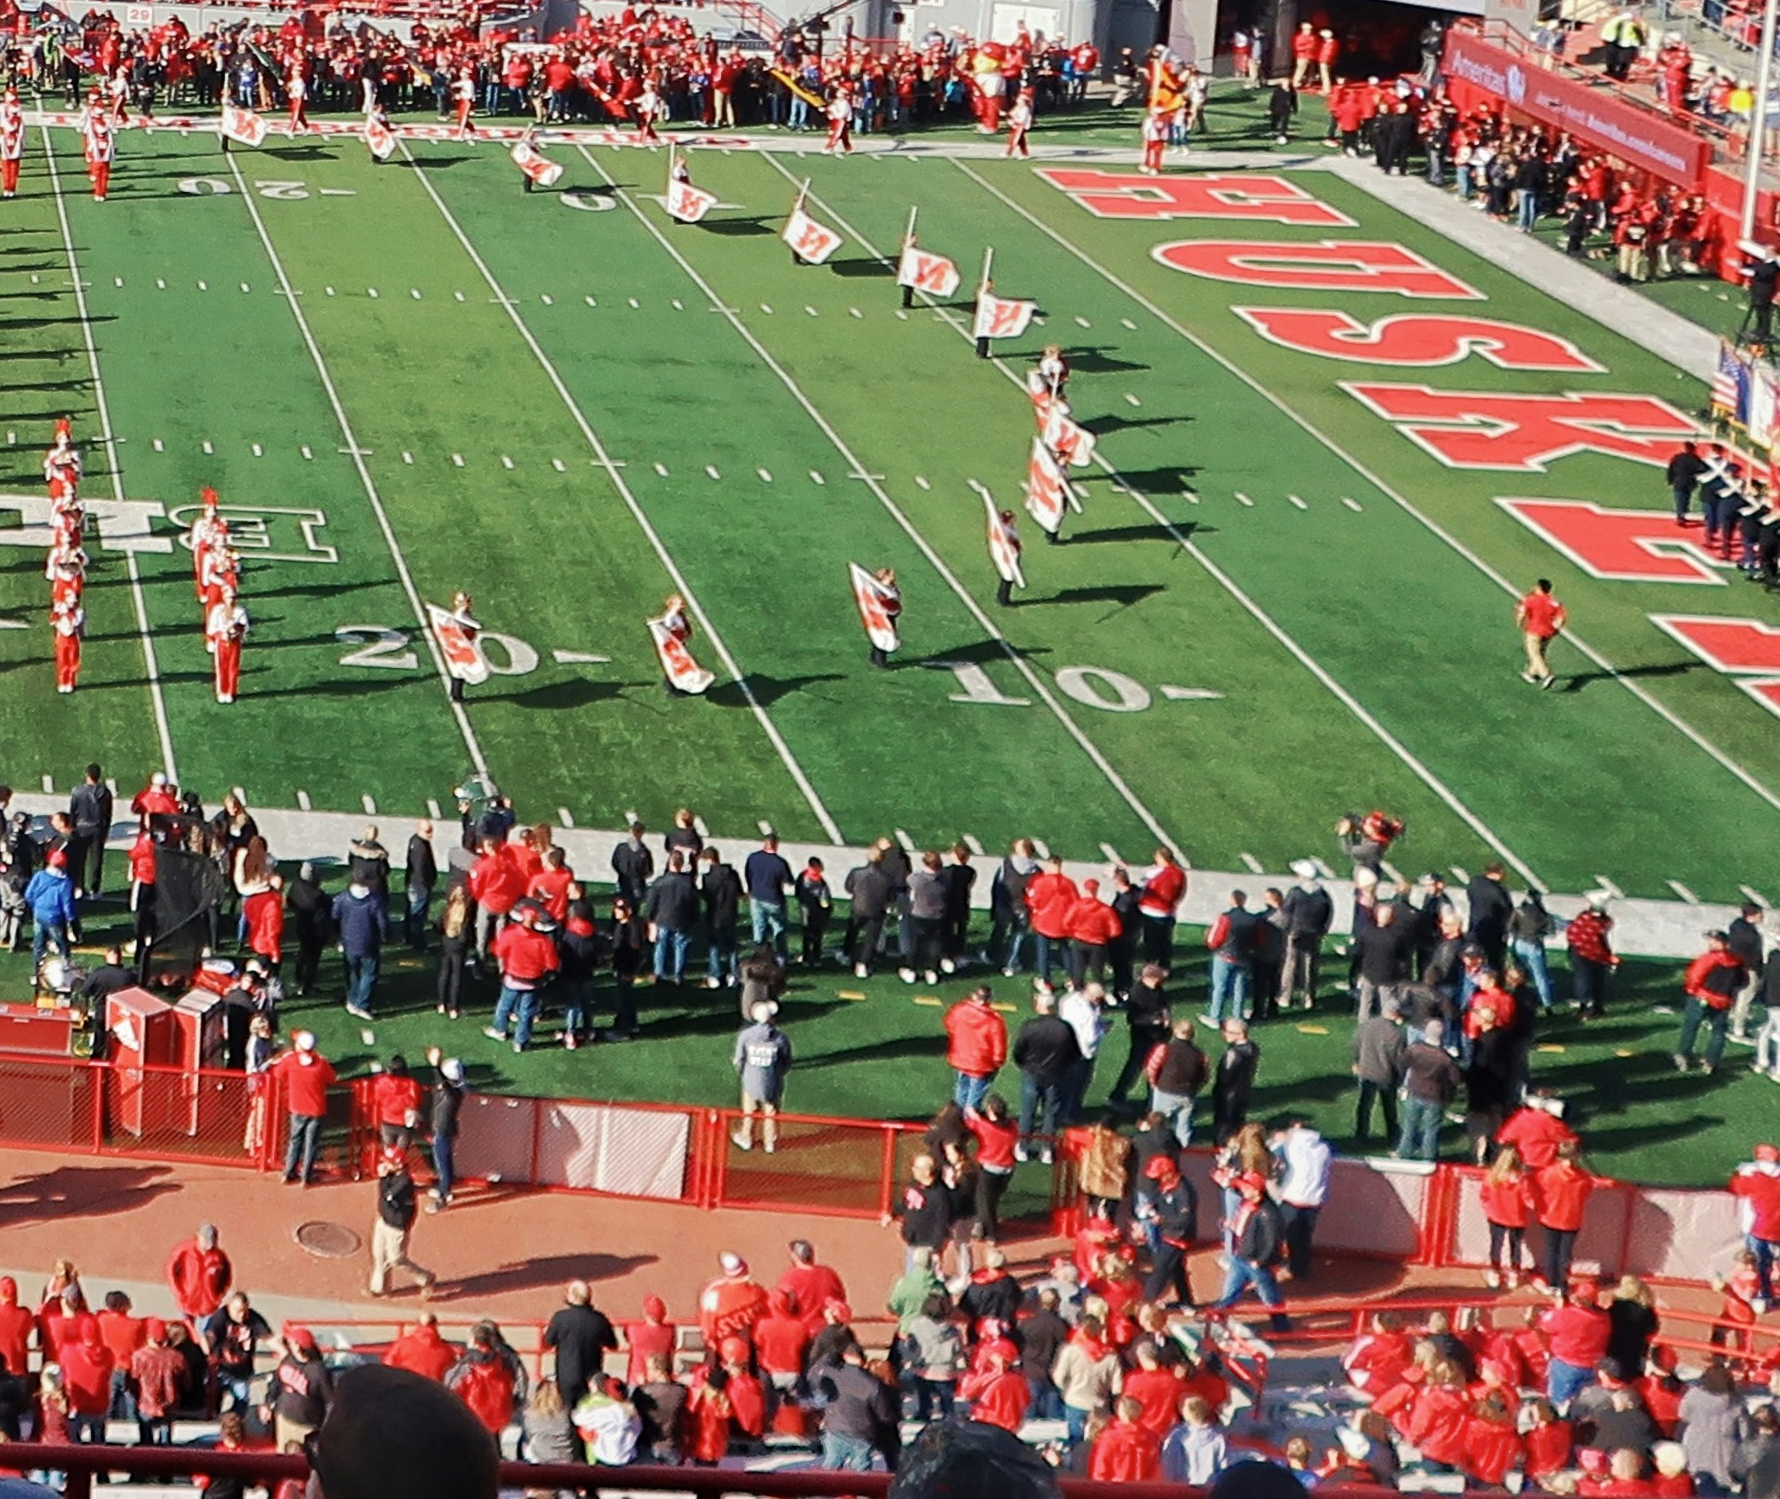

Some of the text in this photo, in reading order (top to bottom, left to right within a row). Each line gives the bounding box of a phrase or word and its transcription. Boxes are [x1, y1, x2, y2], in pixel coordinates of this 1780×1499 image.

[129, 9, 150, 21] 29
[1450, 49, 1507, 97] Ameritas
[920, 660, 1155, 714] 10
